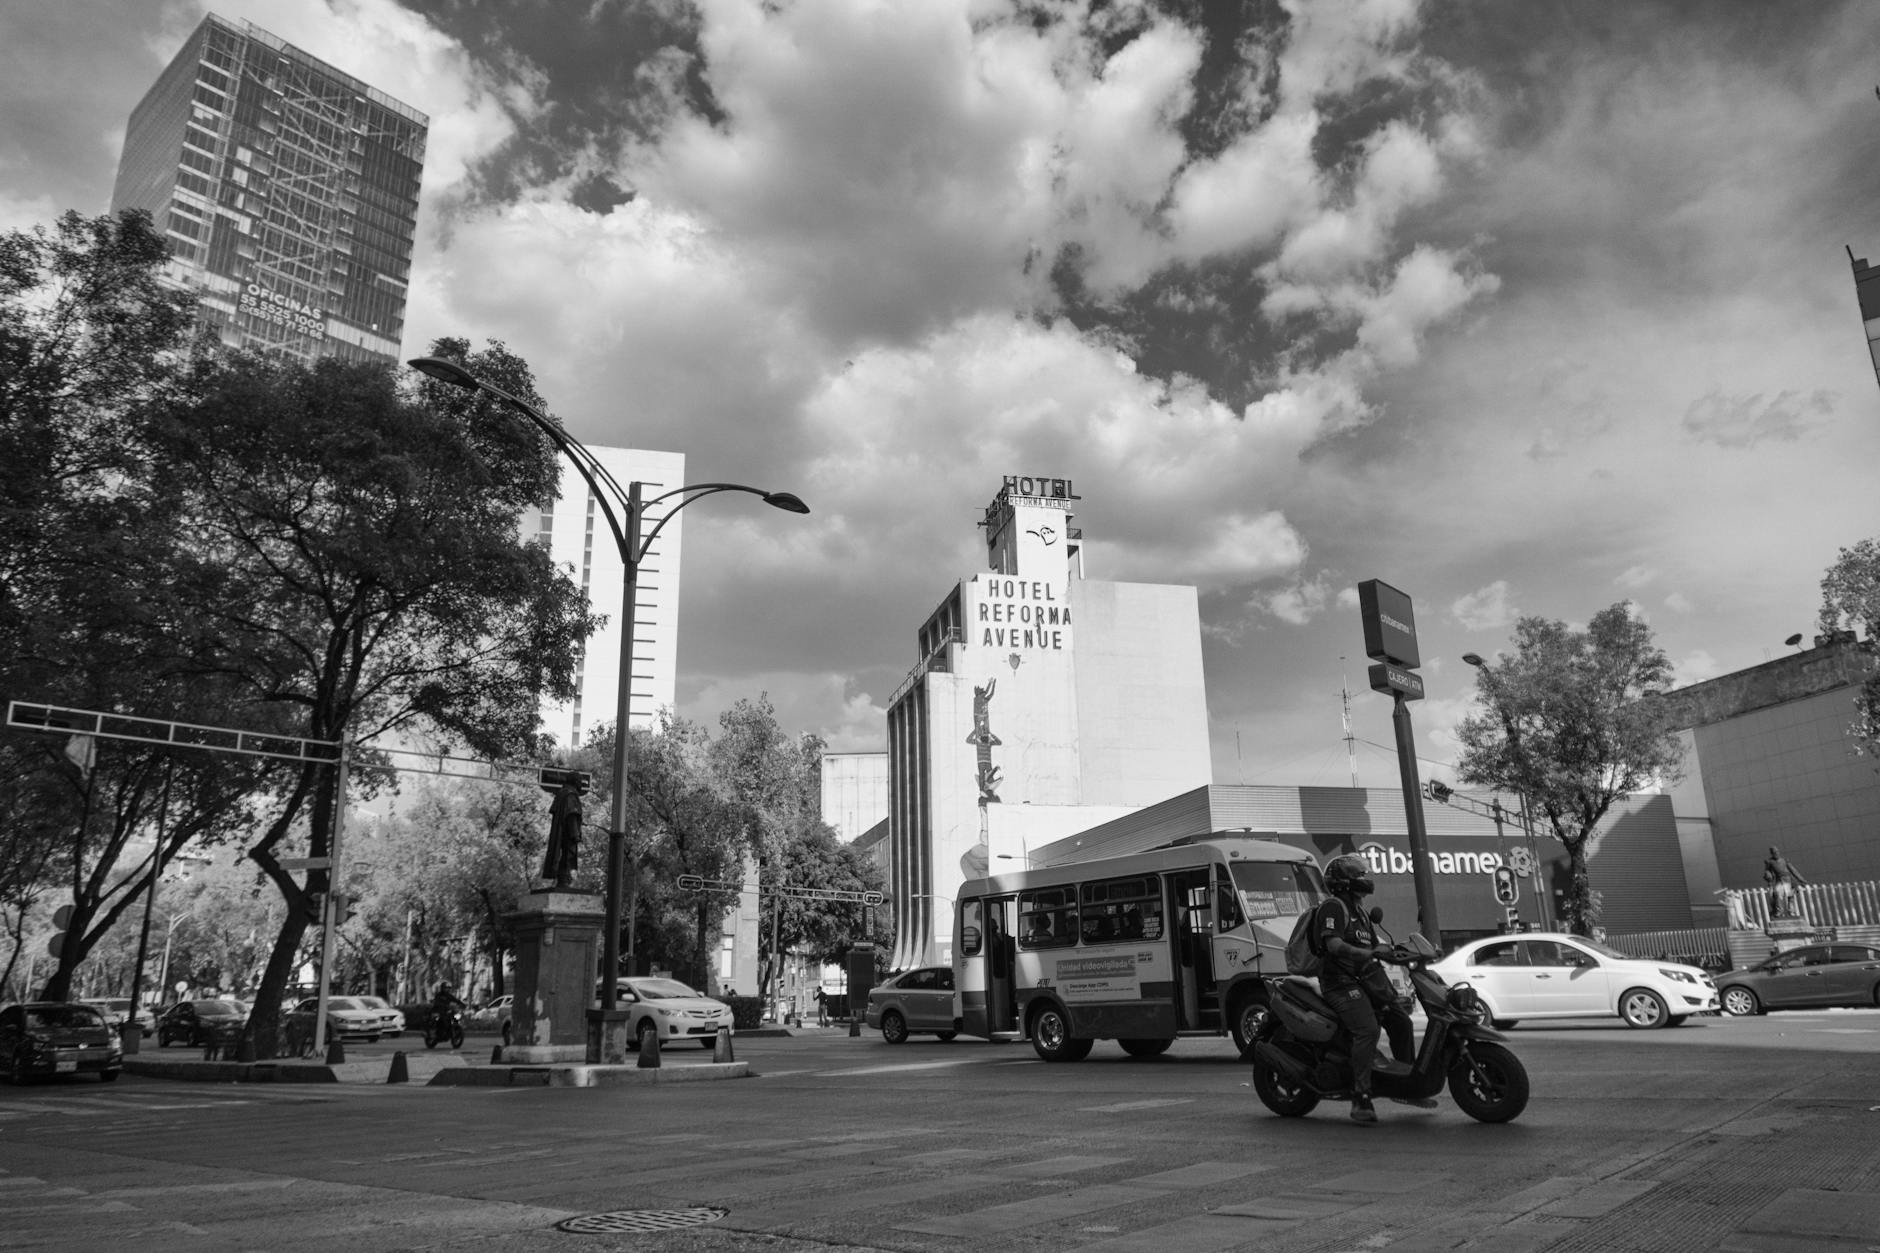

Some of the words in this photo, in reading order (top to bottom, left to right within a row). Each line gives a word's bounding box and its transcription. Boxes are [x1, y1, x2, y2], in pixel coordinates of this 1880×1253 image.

[240, 293, 257, 307] 55
[260, 300, 291, 319] 5525
[294, 313, 325, 333] 1000
[248, 284, 321, 319] OFICINAS
[1003, 475, 1081, 500] HOTEL
[1010, 497, 1043, 507] REFORMA
[1045, 499, 1072, 509] AVENUE
[988, 579, 1055, 601] HOTEL
[979, 602, 1072, 626] REFORMA
[982, 627, 1062, 650] AVENUE
[1388, 671, 1409, 687] CAJERO
[1360, 845, 1503, 875] tibname
